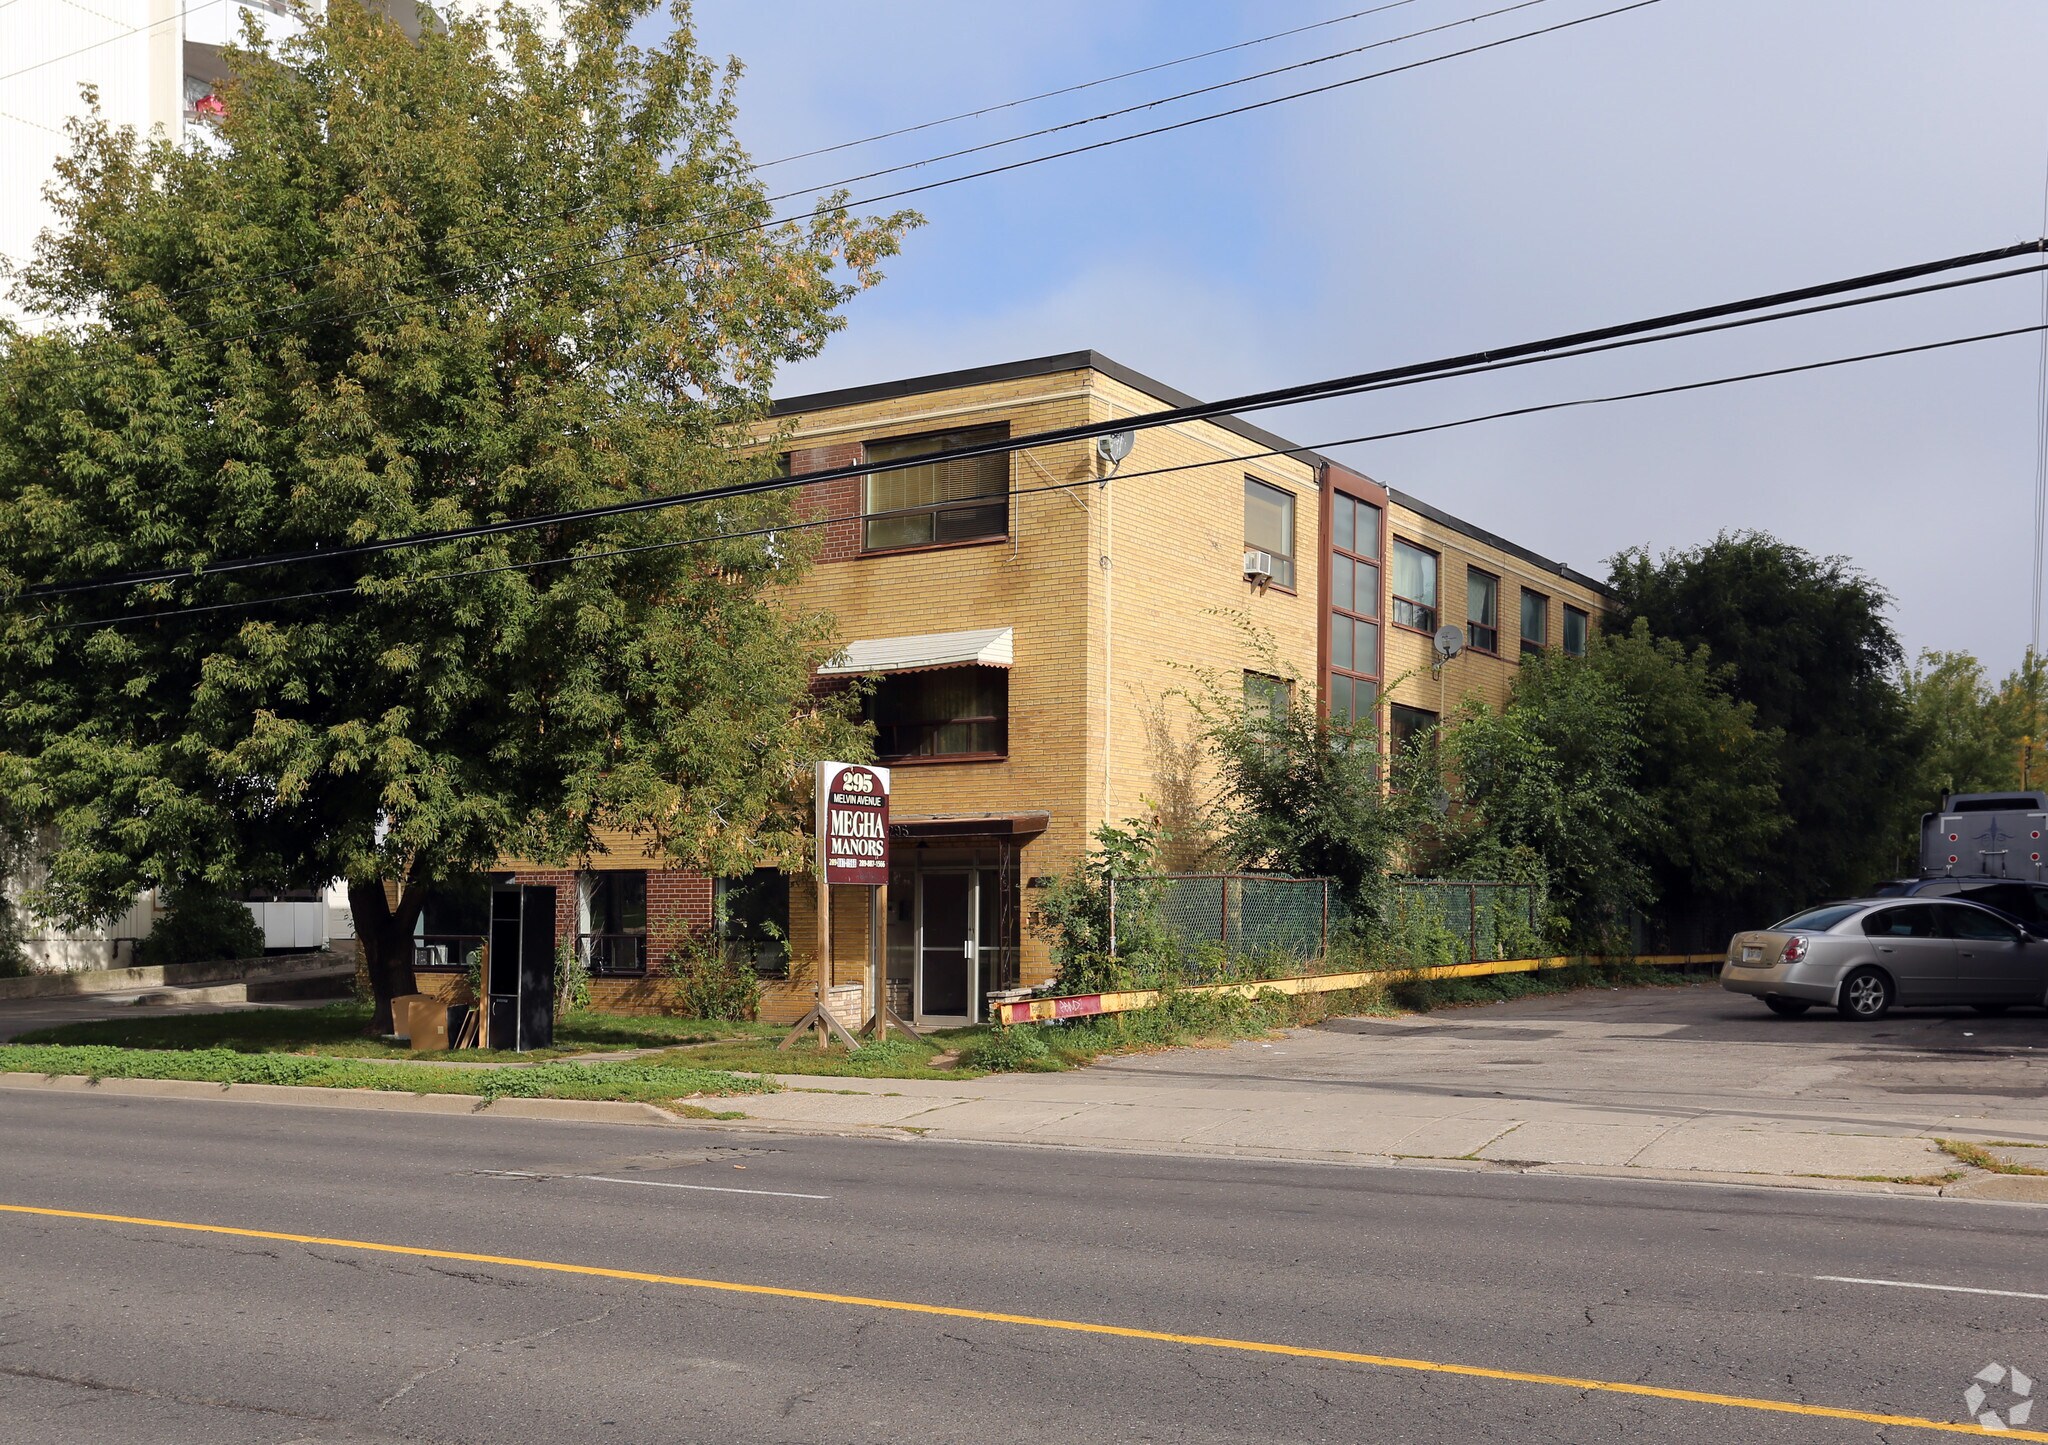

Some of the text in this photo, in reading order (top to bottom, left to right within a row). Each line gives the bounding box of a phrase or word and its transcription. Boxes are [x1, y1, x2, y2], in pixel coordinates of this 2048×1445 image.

[842, 772, 873, 793] 295
[833, 793, 882, 806] MELVIN AVENUE
[830, 809, 885, 838] MEGHA
[831, 838, 884, 856] MANORS
